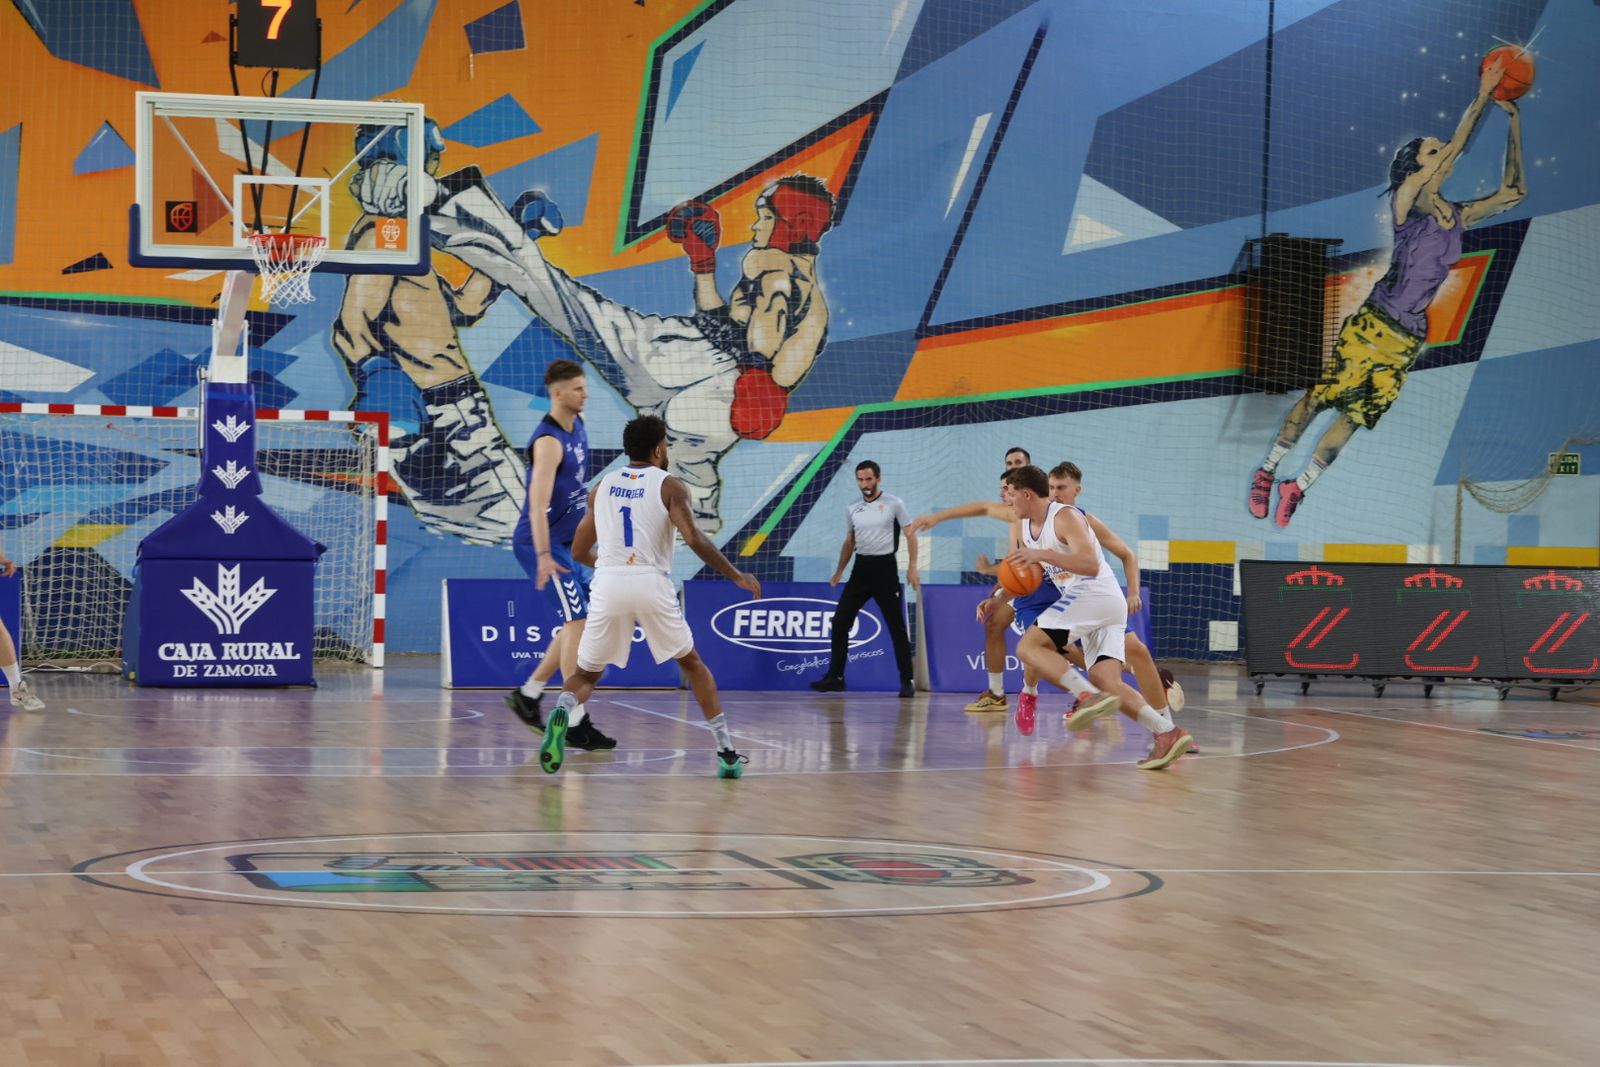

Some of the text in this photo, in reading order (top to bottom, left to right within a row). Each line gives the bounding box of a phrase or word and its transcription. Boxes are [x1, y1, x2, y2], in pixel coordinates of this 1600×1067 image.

[260, 0, 293, 40] 7
[1551, 455, 1578, 464] LIDA
[609, 486, 645, 499] POIRIER
[619, 505, 634, 547] 1
[482, 625, 646, 643] DISO
[158, 641, 301, 662] CAJA RURAL
[511, 651, 547, 659] UVA TIN
[966, 651, 1025, 671] VÍ D
[172, 664, 278, 678] DE ZAMORA
[776, 655, 830, 675] Congelados
